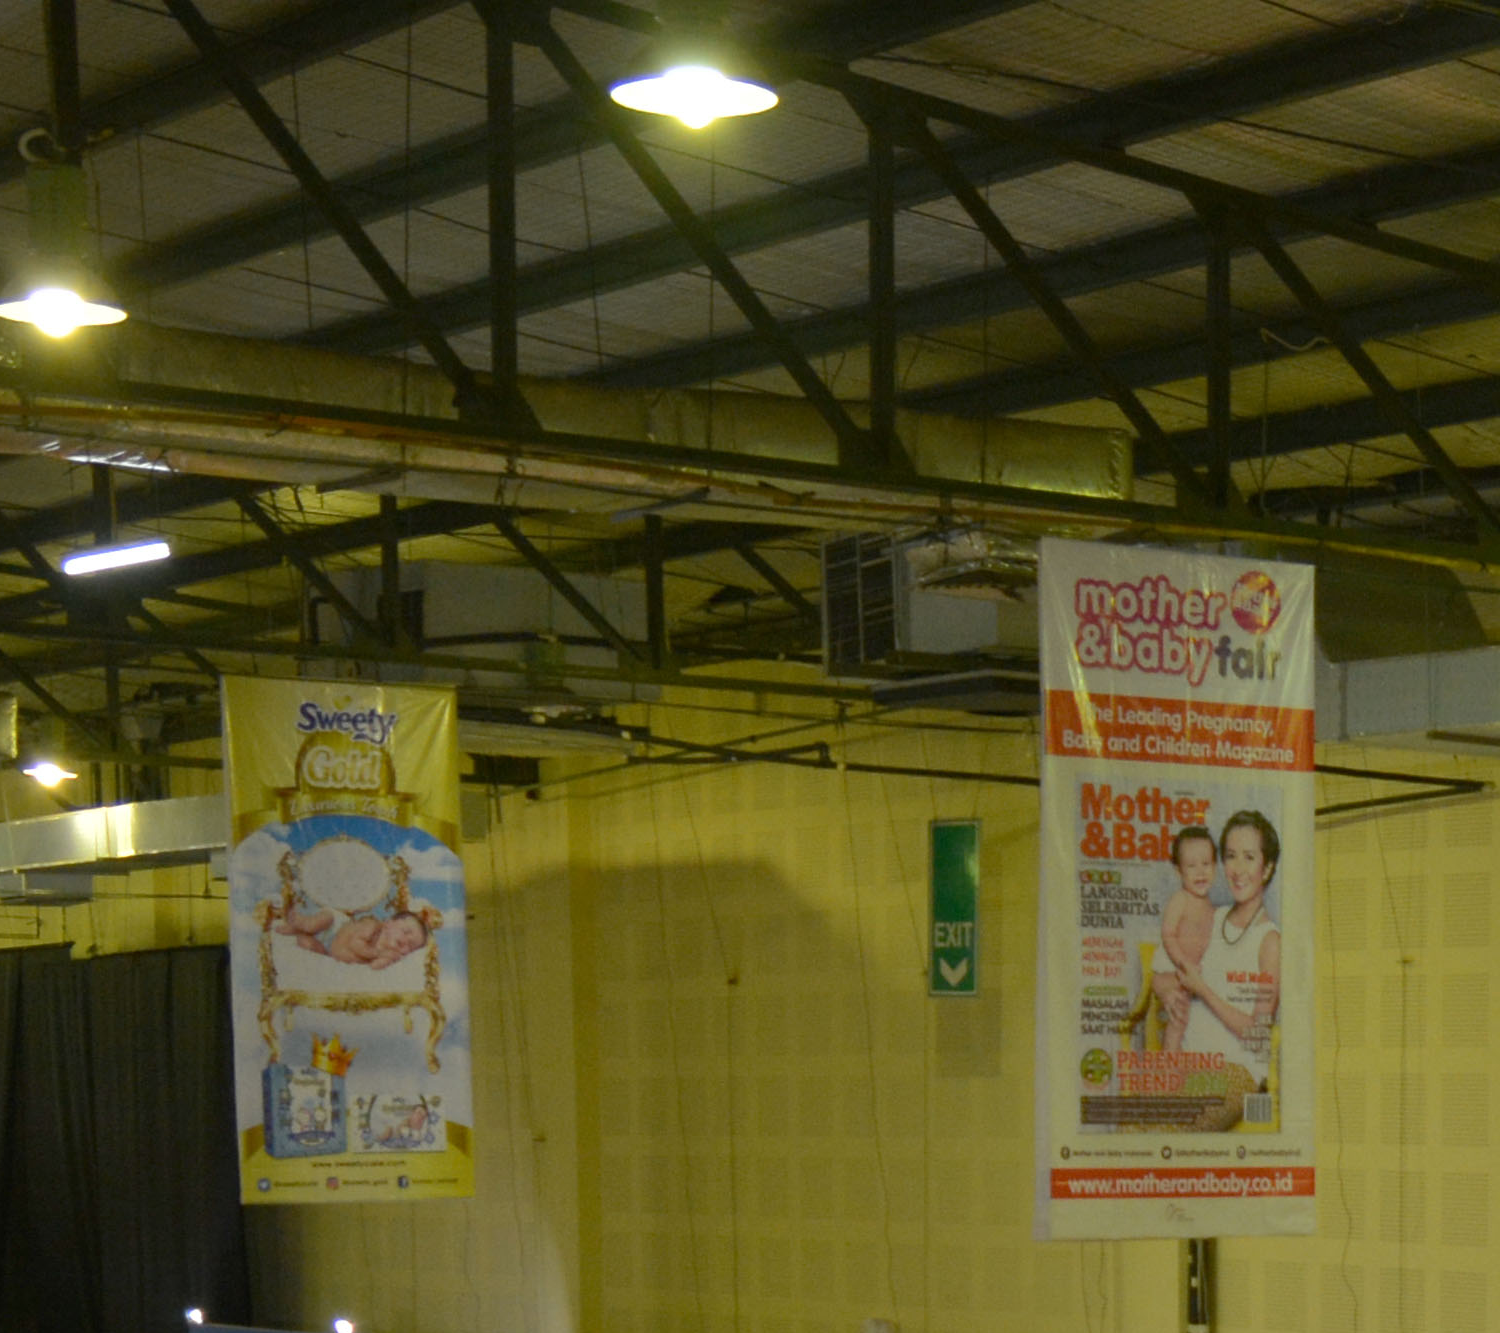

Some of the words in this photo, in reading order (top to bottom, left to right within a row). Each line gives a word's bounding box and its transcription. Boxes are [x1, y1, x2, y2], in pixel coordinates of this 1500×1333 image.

[1075, 573, 1227, 629] mother
[1076, 620, 1213, 686] &baby
[1215, 635, 1281, 681] fair
[297, 702, 397, 745] Sweety
[1118, 705, 1183, 732] Leading
[1187, 709, 1275, 738] Pregnancy,
[1107, 734, 1141, 754] and
[1144, 736, 1212, 759] Children
[1216, 740, 1295, 766] Magazine
[303, 745, 382, 790] Gold
[1080, 782, 1210, 826] Mother
[1080, 885, 1149, 903] LANGSING
[934, 920, 974, 948] EXIT
[1116, 1050, 1225, 1072] PARENTING
[1116, 1072, 1182, 1093] TREND
[1067, 1171, 1293, 1198] www.motherandbaby.co.id
